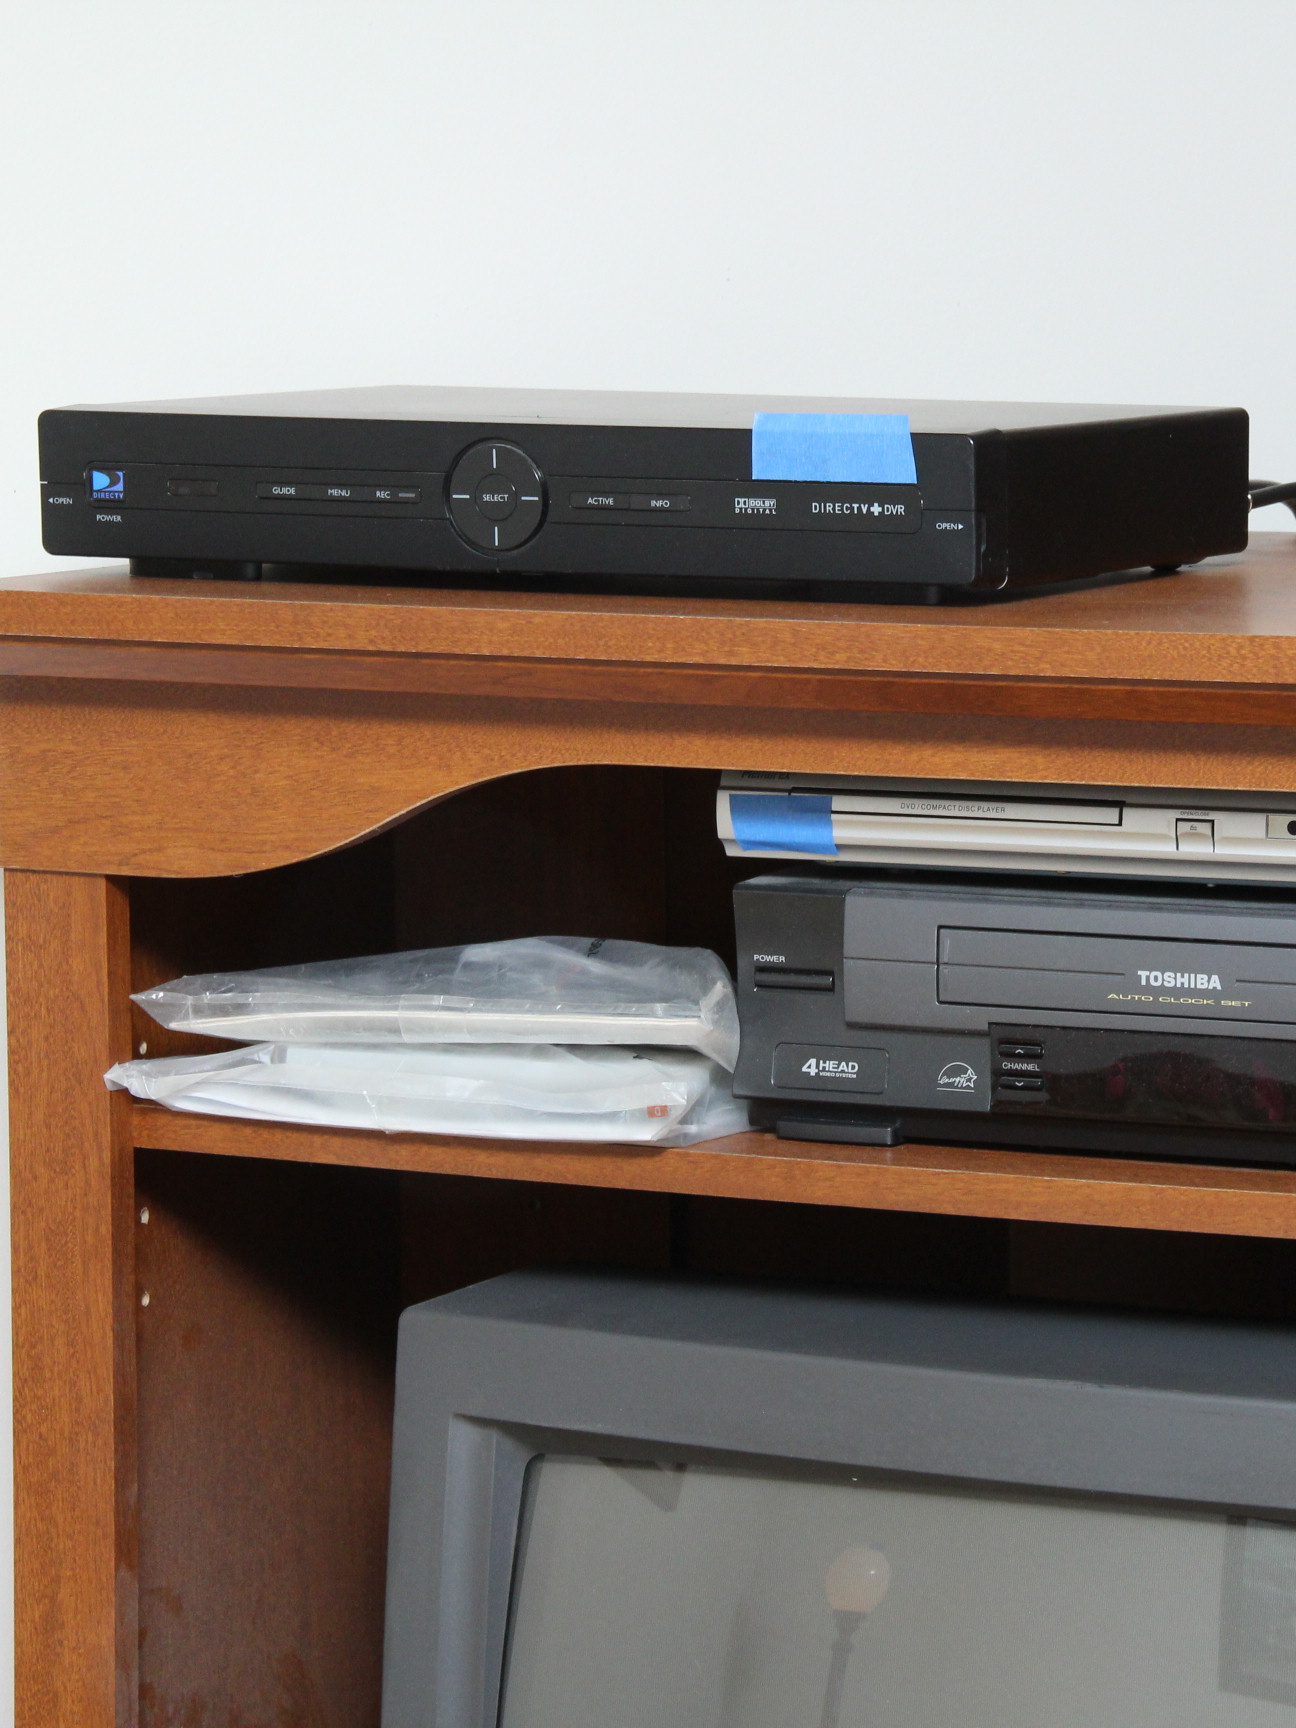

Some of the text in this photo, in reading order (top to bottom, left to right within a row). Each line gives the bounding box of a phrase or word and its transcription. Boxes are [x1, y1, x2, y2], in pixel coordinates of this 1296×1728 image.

[272, 486, 296, 495] GUIDE
[327, 488, 351, 497] MENU
[376, 490, 391, 499] REC
[54, 497, 73, 505] OPEN
[482, 493, 509, 502] SELECT
[587, 496, 614, 505] ACTIVE
[650, 499, 670, 508] INFO
[750, 500, 775, 508] DOLBY
[96, 514, 122, 523] POWER
[936, 522, 958, 531] OPEN
[977, 806, 1006, 814] PLAYER
[753, 954, 786, 963] POWER
[1137, 970, 1222, 990] TOSHIBA
[1107, 993, 1153, 1001] AUTO
[1159, 996, 1215, 1005] CLOCK
[1002, 1061, 1040, 1071] CHANNEL
